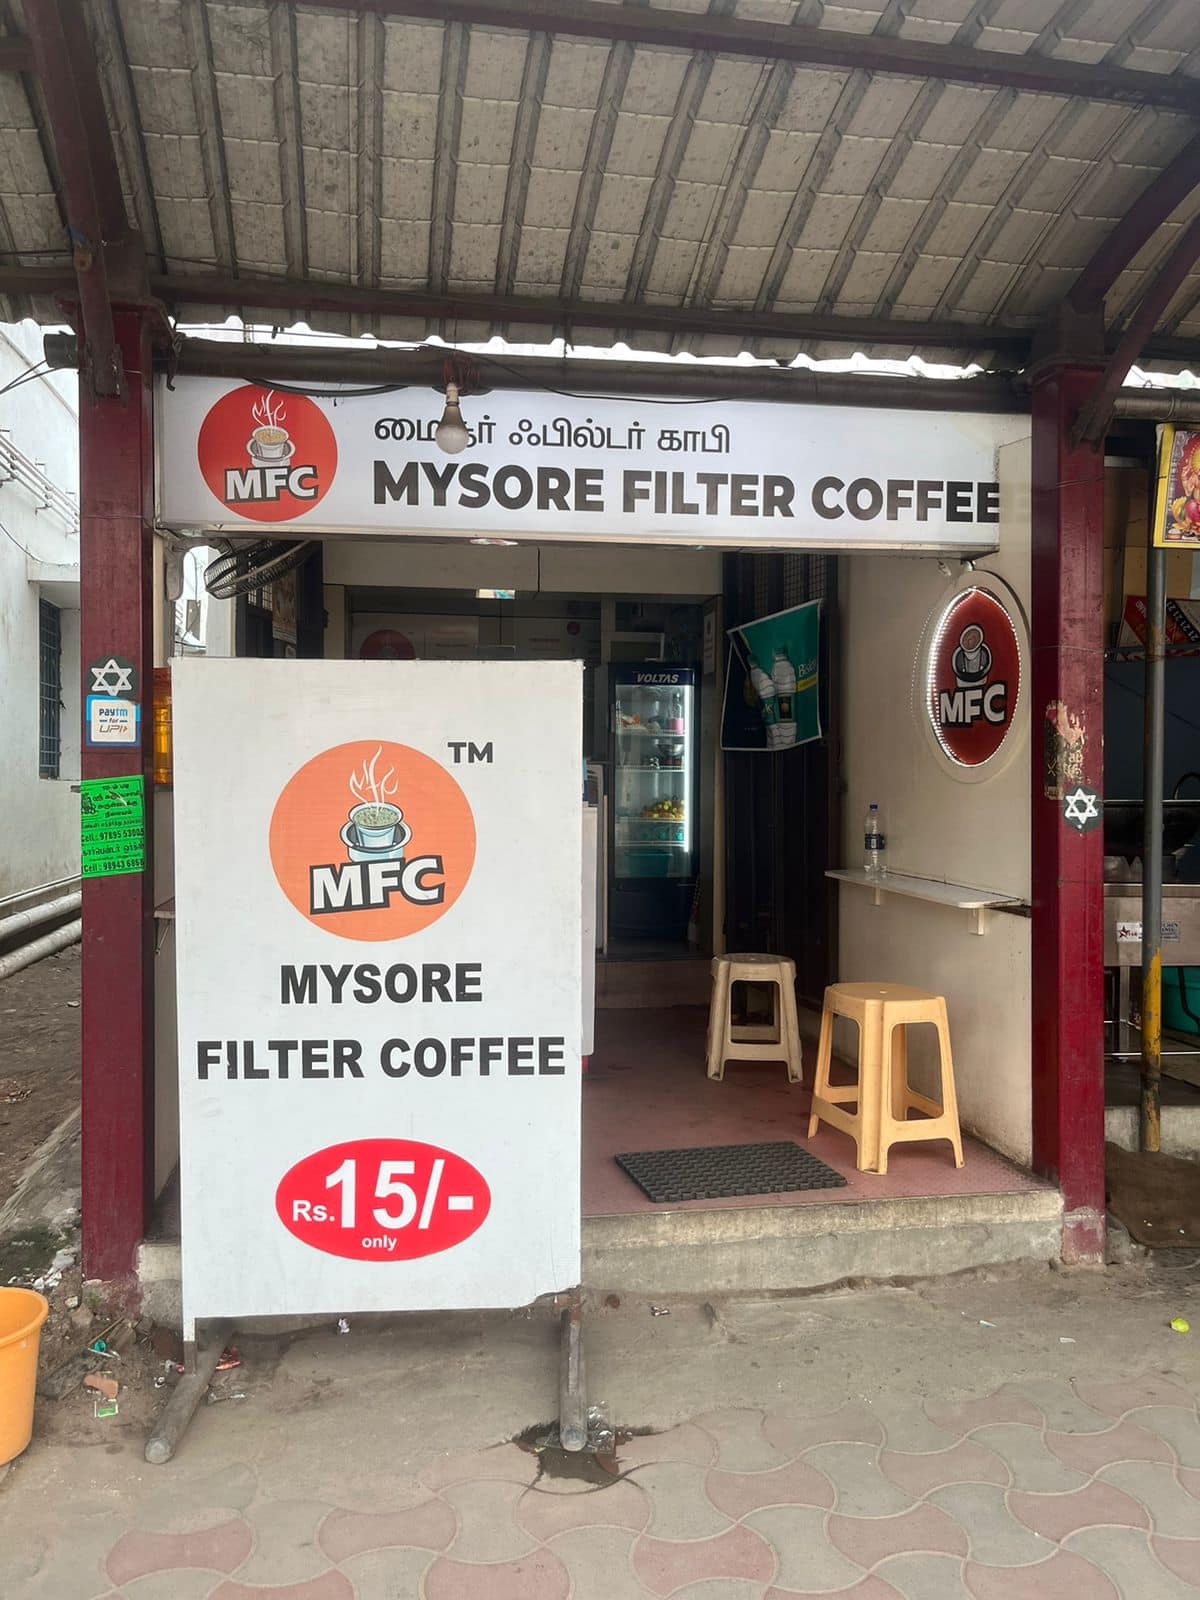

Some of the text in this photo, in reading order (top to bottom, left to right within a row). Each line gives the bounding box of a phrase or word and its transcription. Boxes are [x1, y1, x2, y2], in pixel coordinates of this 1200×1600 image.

[657, 423, 731, 453] காபி
[224, 466, 319, 503] MFC
[373, 460, 999, 523] MYSORE FILTER COFFEE
[636, 674, 680, 684] VOLTAS
[939, 683, 1007, 726] MFC
[447, 742, 493, 763] TM
[309, 854, 446, 915] MFC
[280, 963, 482, 1005] MYSORE
[197, 1037, 565, 1081] FILTER COFFEE
[292, 1158, 474, 1230] Rs. 15/-
[361, 1235, 398, 1251] only
